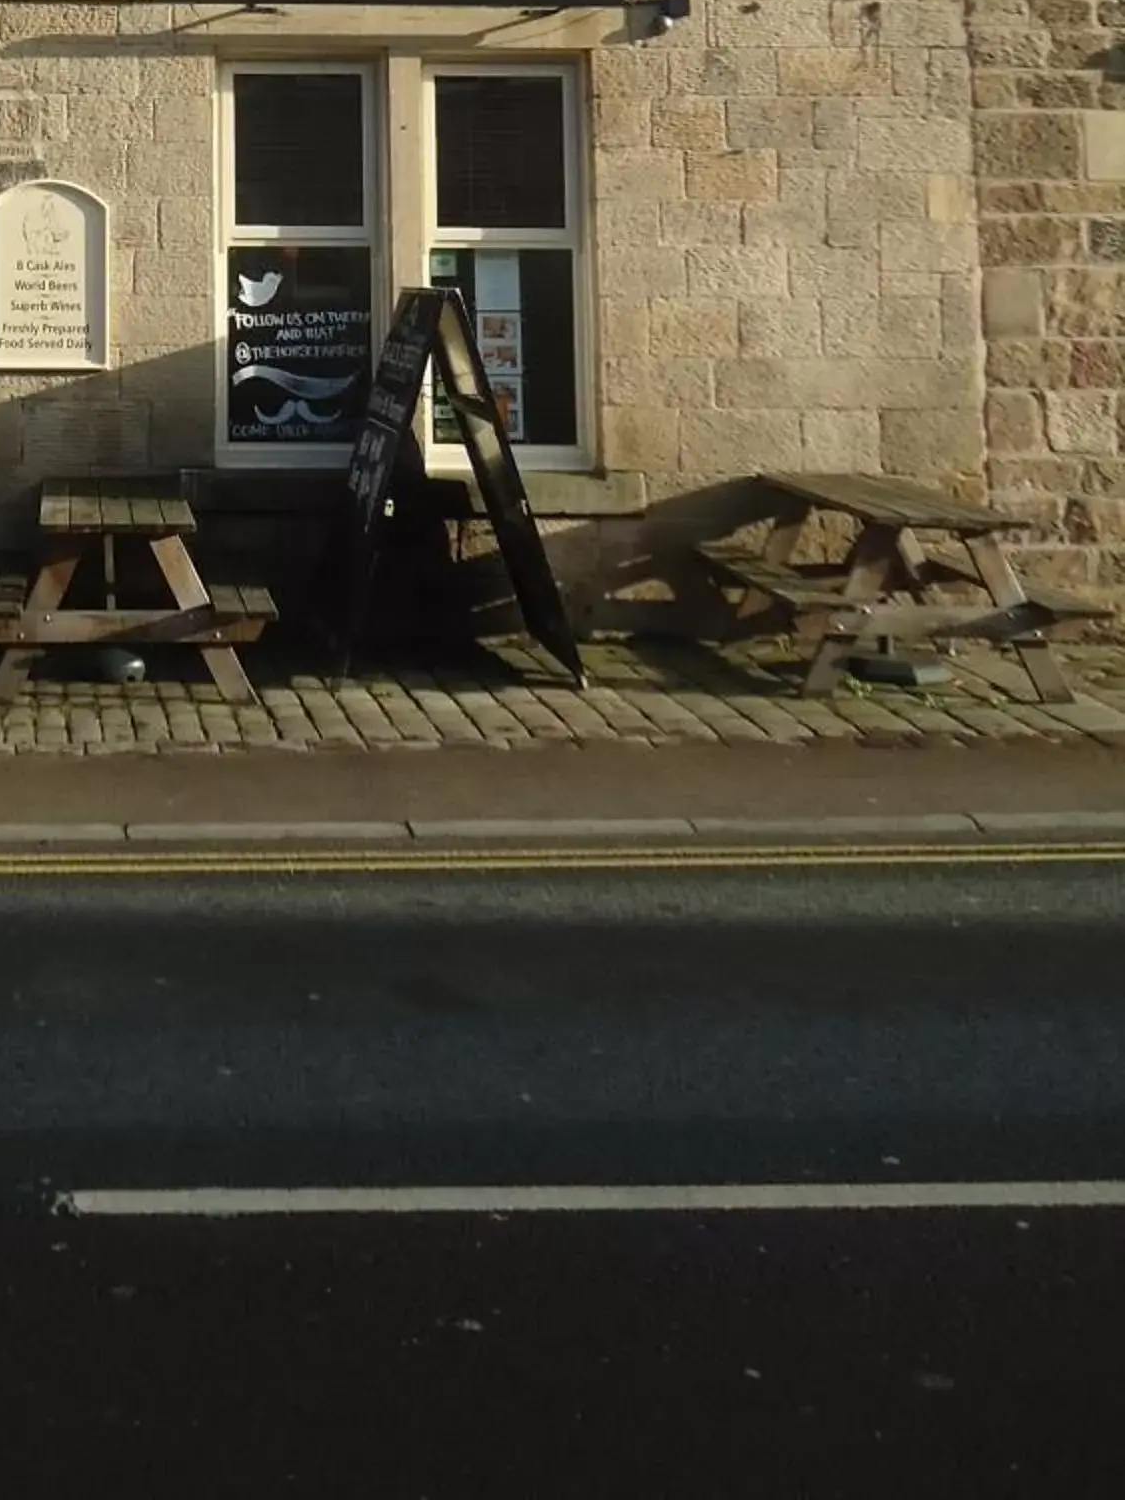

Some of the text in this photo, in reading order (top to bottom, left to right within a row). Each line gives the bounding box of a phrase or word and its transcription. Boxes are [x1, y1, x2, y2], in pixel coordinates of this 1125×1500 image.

[26, 260, 49, 271] Cask
[53, 260, 76, 271] Ales
[14, 280, 78, 291] World Beers
[10, 300, 81, 312] Superb Wines
[304, 311, 326, 324] ON
[2, 323, 90, 336] Freshly Prepared
[28, 338, 64, 349] Served
[66, 338, 93, 352] Daily
